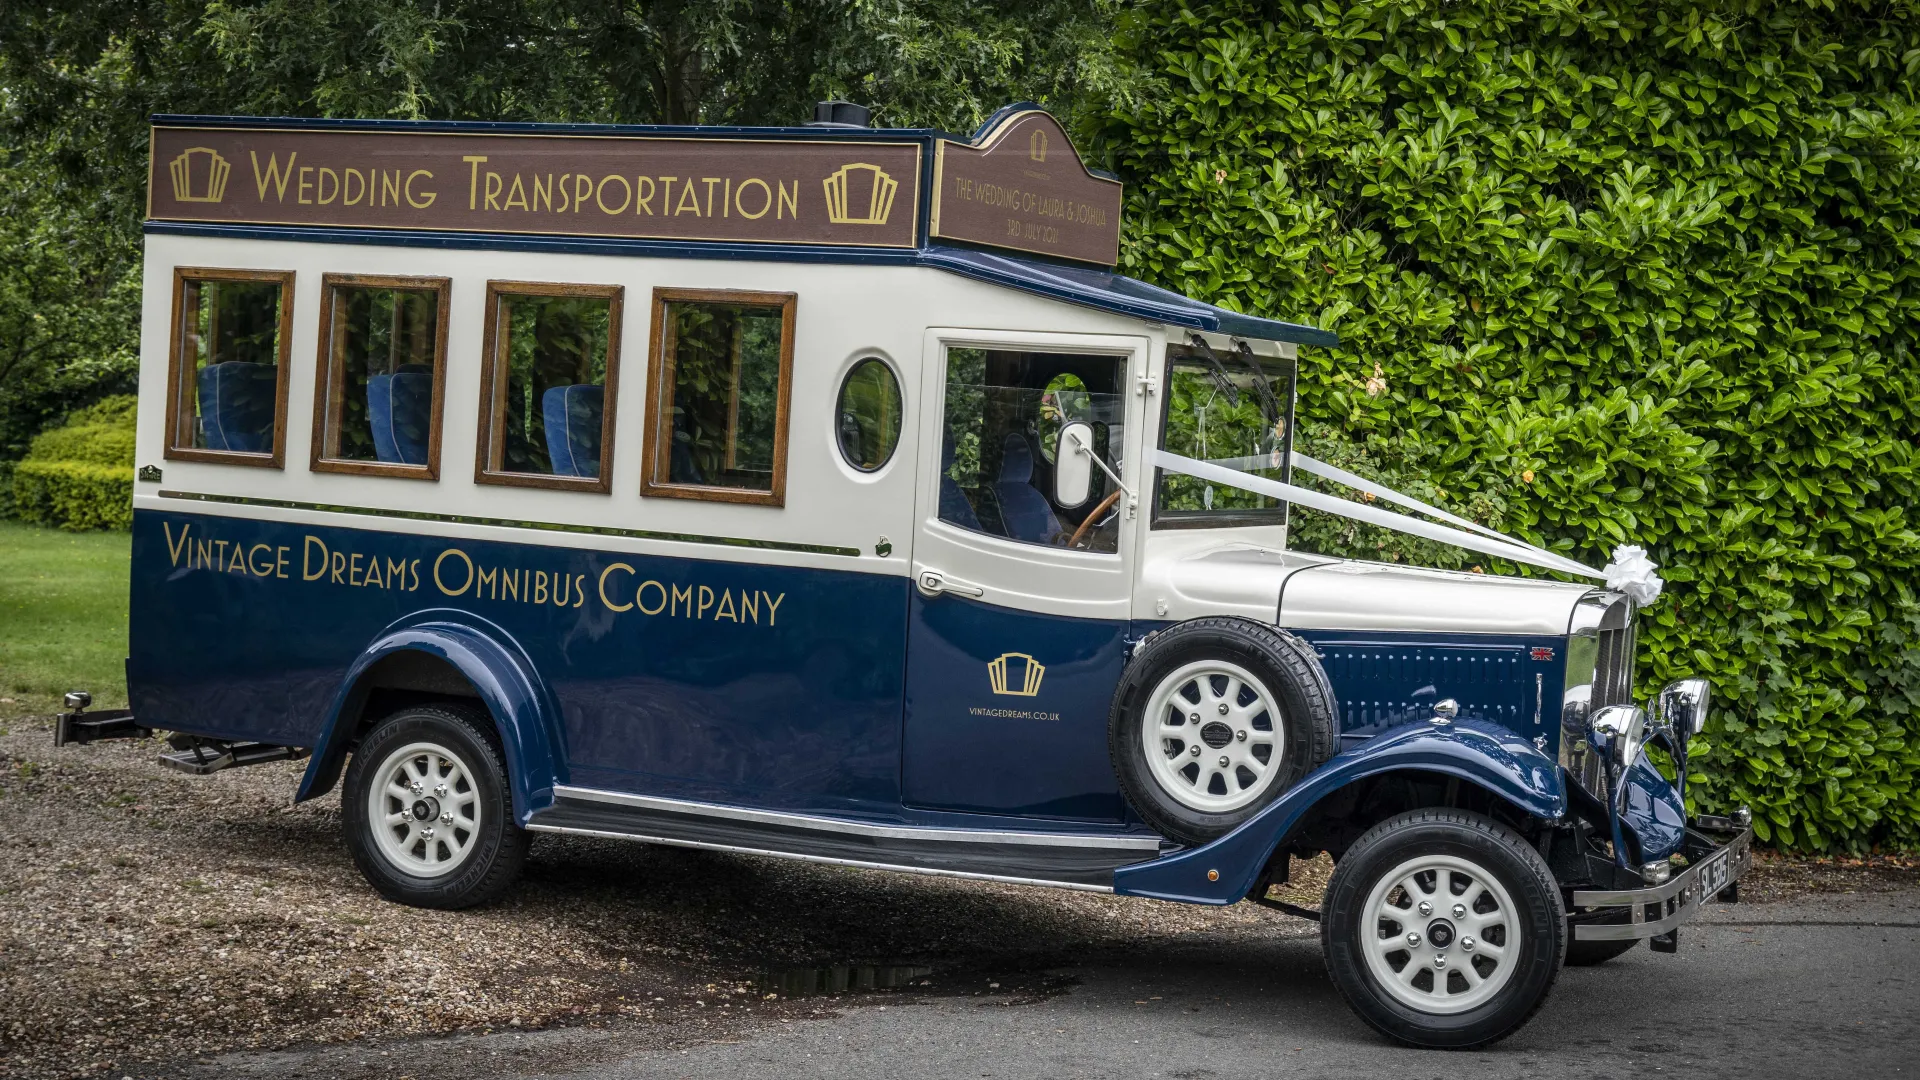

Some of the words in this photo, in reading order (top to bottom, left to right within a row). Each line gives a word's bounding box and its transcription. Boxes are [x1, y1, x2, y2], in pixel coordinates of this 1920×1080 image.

[956, 177, 972, 201] THE
[975, 182, 1020, 211] WEDDING
[1022, 192, 1036, 212] OF
[1038, 195, 1064, 219] LAURA
[1074, 204, 1106, 227] JOSHUA
[1007, 219, 1020, 237] 3RD
[1024, 224, 1041, 242] JULY
[969, 707, 1060, 721] VINTAGEDREAMS.CO.UK
